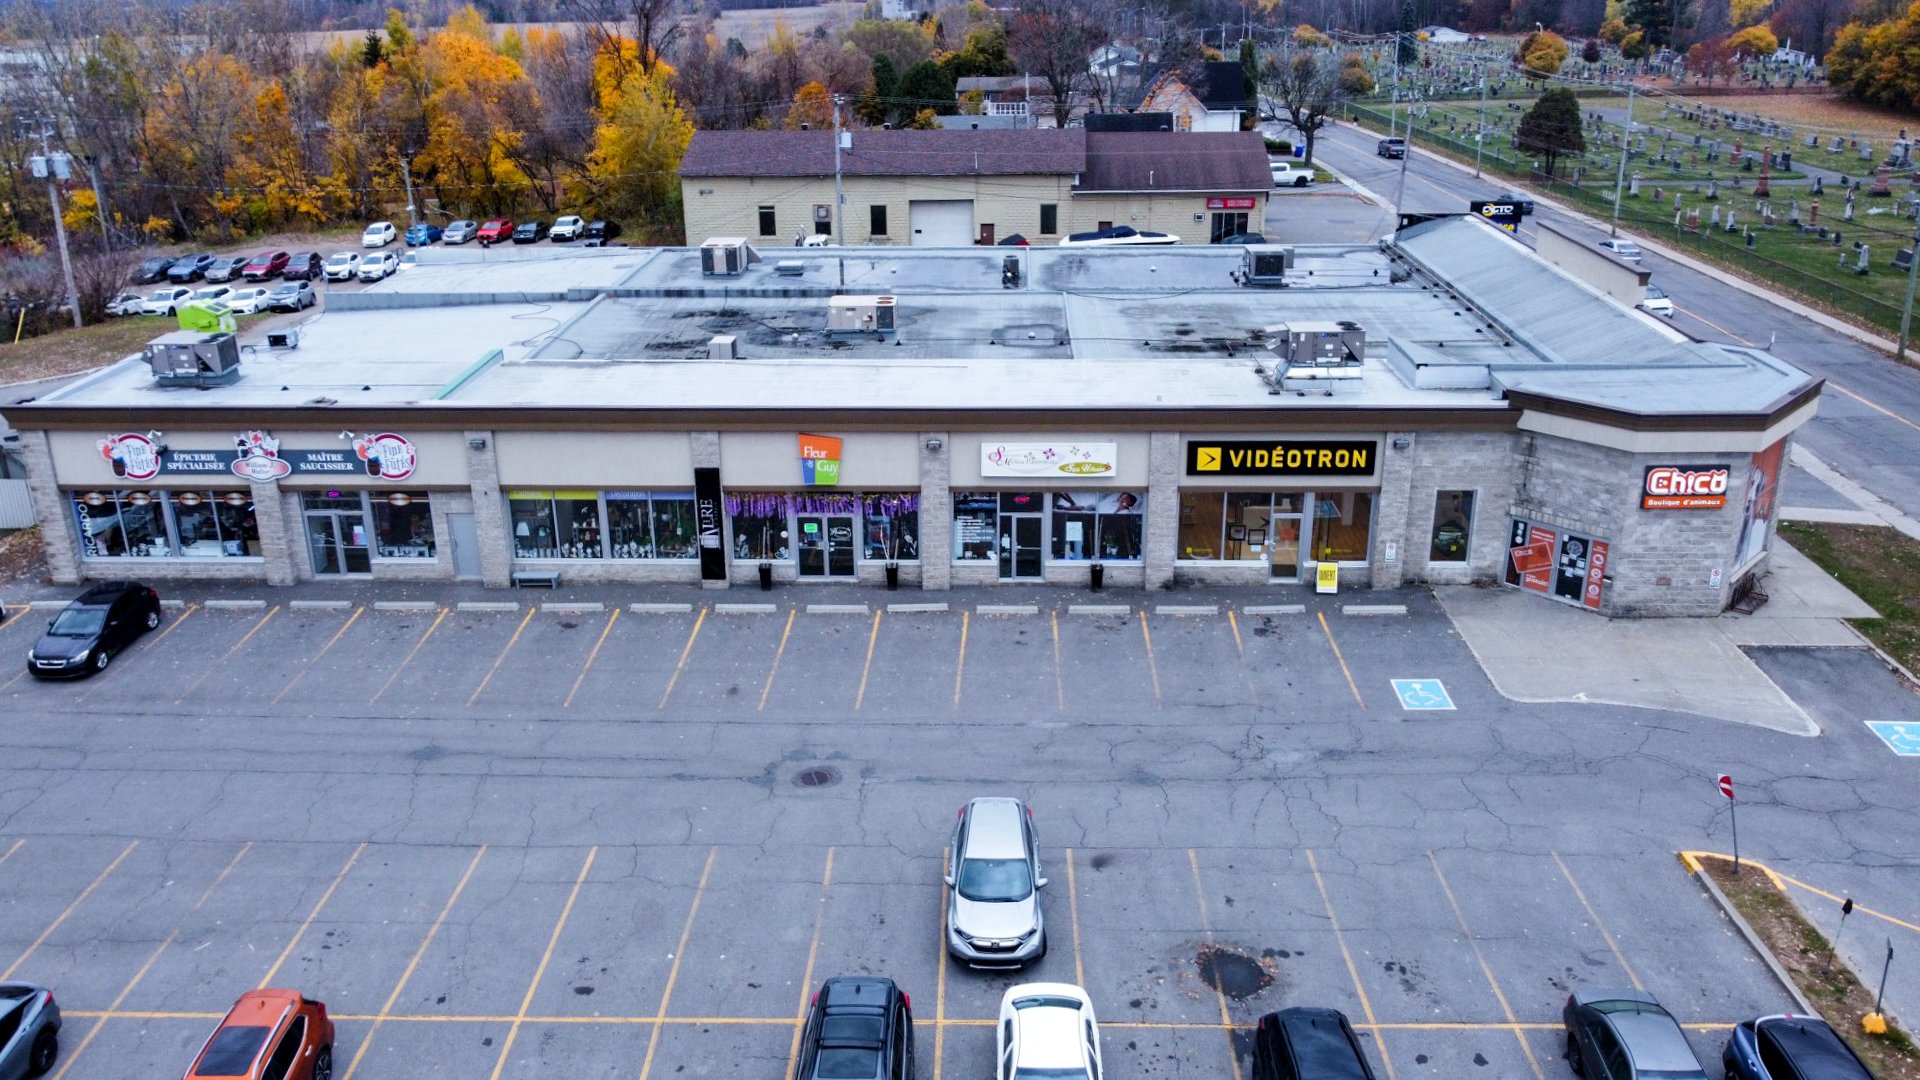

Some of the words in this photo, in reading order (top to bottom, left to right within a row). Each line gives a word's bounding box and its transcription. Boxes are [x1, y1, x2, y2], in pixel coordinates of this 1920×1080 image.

[173, 452, 217, 461] ÉPICERIE
[307, 452, 344, 461] MAÎTRE
[804, 445, 827, 458] Fleur
[1229, 446, 1367, 468] VIDÉOTRON
[167, 460, 227, 470] SPÉCIALISÉE
[300, 462, 354, 470] SAUCISSIER
[816, 459, 837, 476] Guy
[1648, 468, 1727, 494] Chico
[1683, 498, 1721, 506] d'animaux
[78, 504, 98, 557] RICARDO
